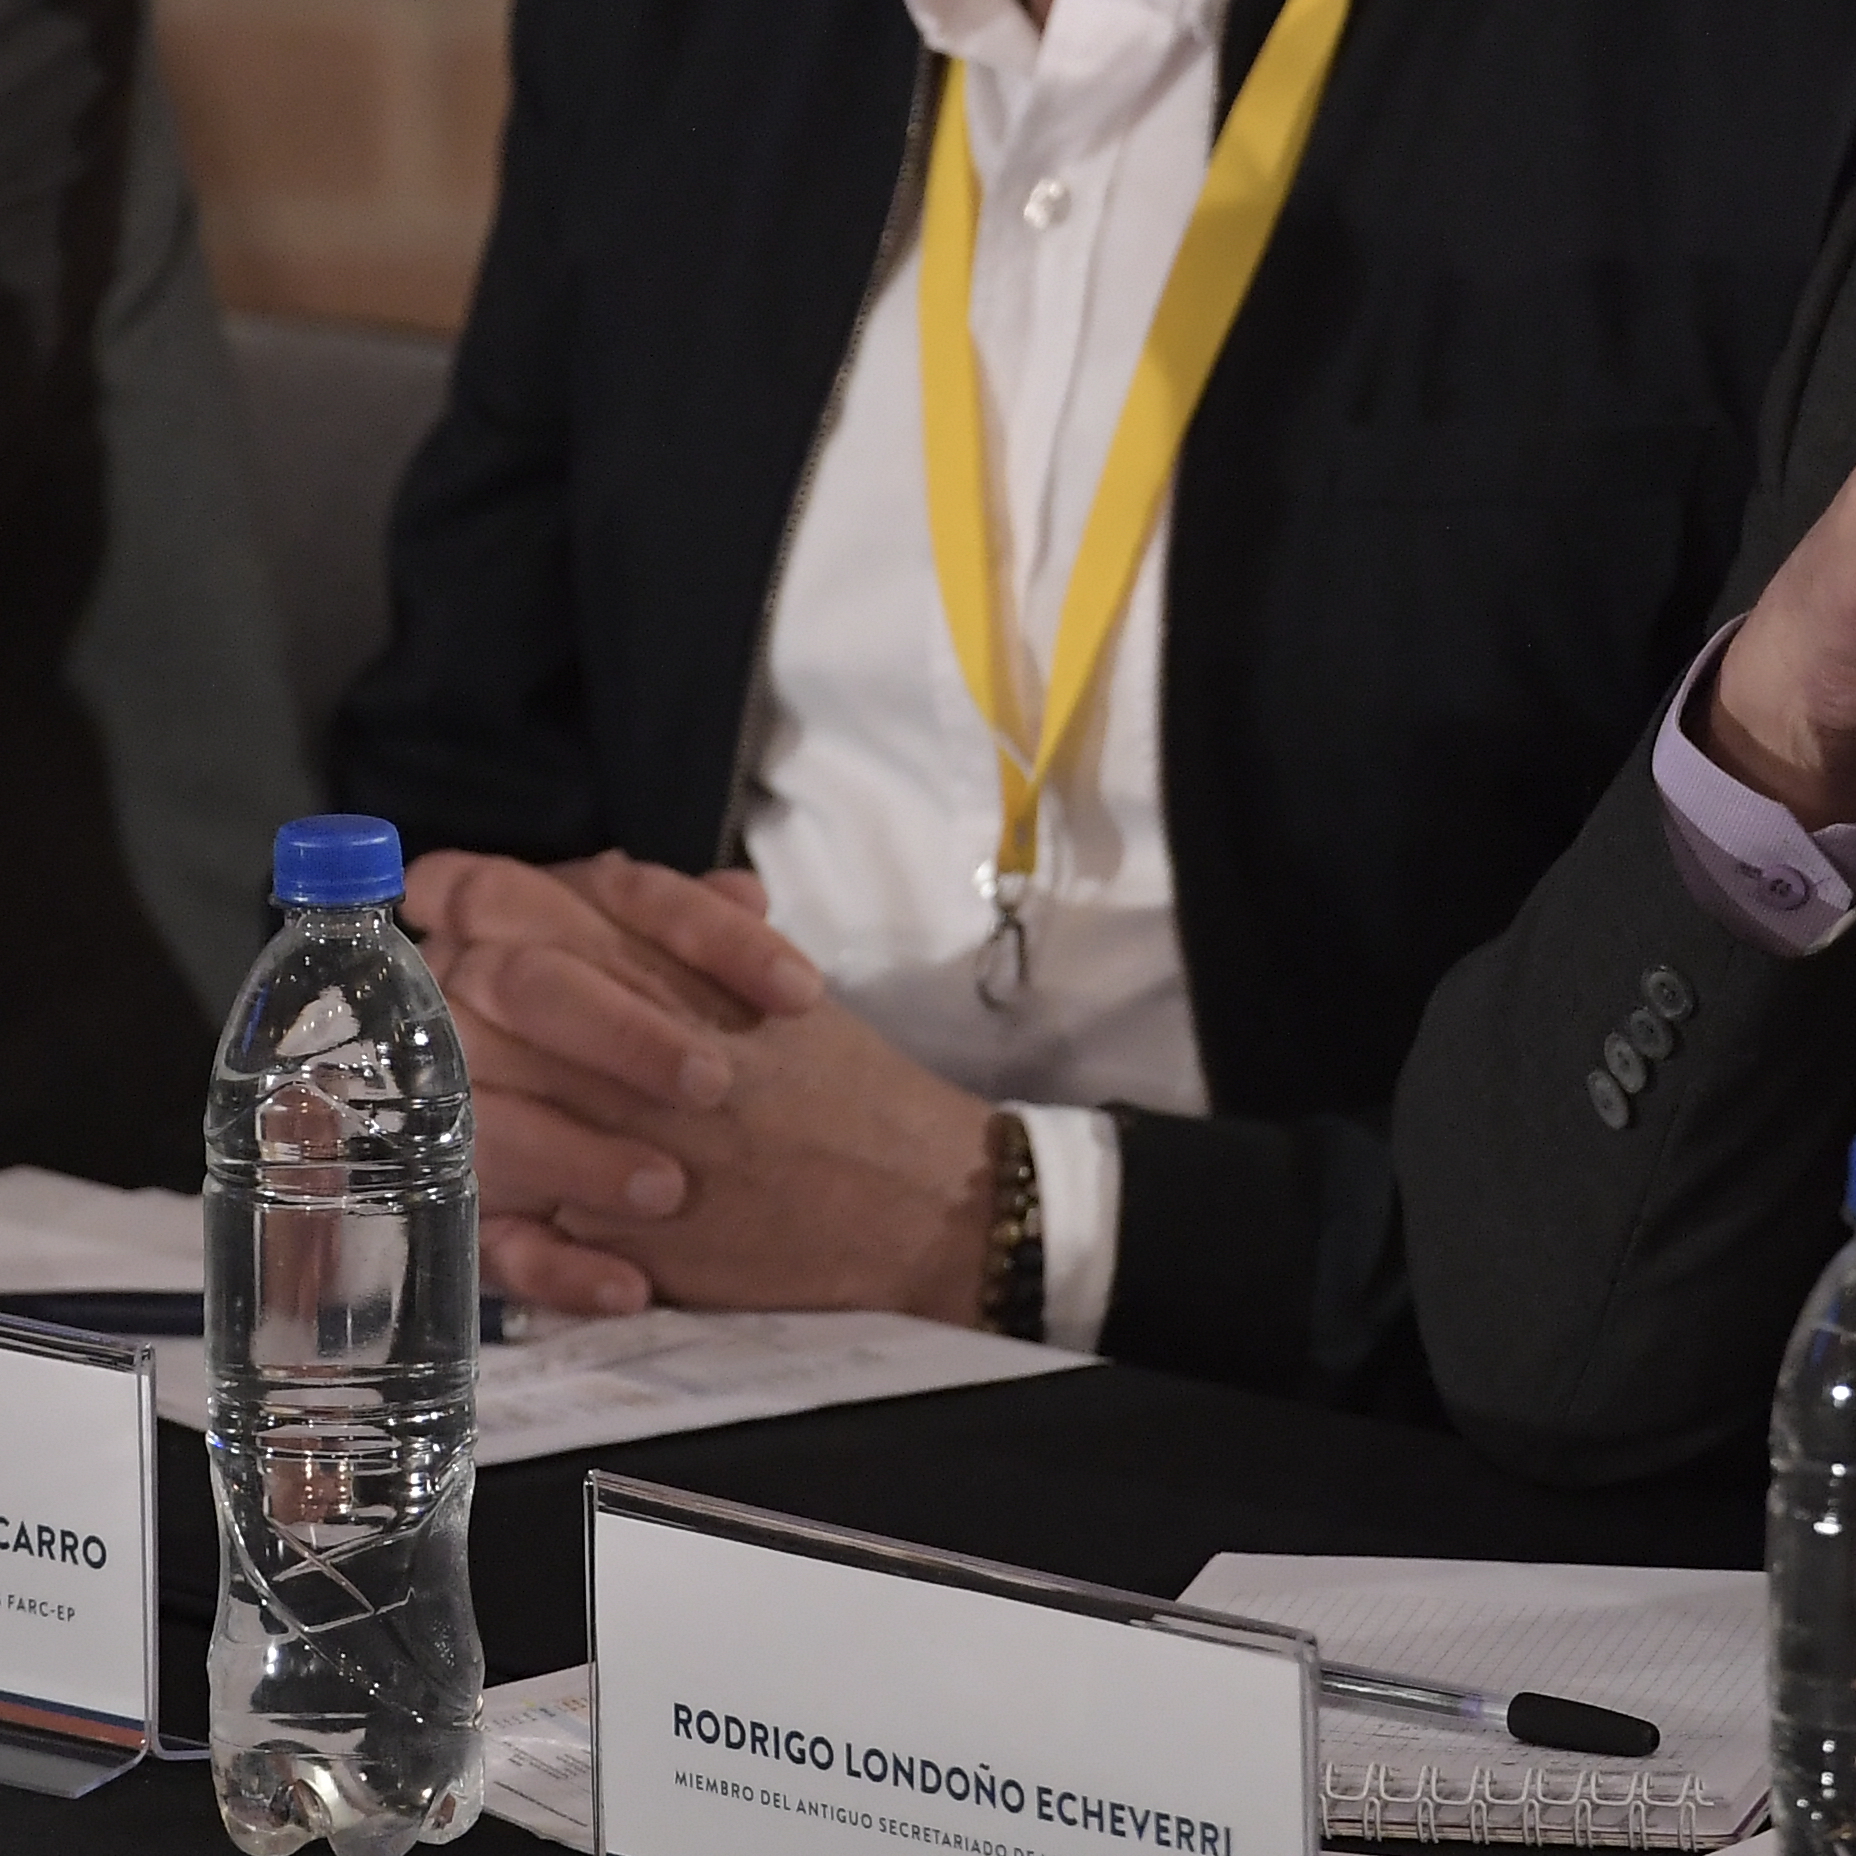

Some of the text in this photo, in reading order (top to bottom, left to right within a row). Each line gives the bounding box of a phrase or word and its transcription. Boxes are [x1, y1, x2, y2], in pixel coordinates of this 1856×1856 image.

[7, 1593, 76, 1623] FARC-EP
[673, 1701, 835, 1772] RODRIGO
[844, 1741, 1026, 1815] LONDOÑO
[1035, 1784, 1232, 1856] ECHEVERRI
[674, 1767, 755, 1802] MIEMBRO
[759, 1789, 792, 1812] DEL
[795, 1797, 874, 1830] ANTIGUO
[878, 1816, 1009, 1856] SECRETARIADO
